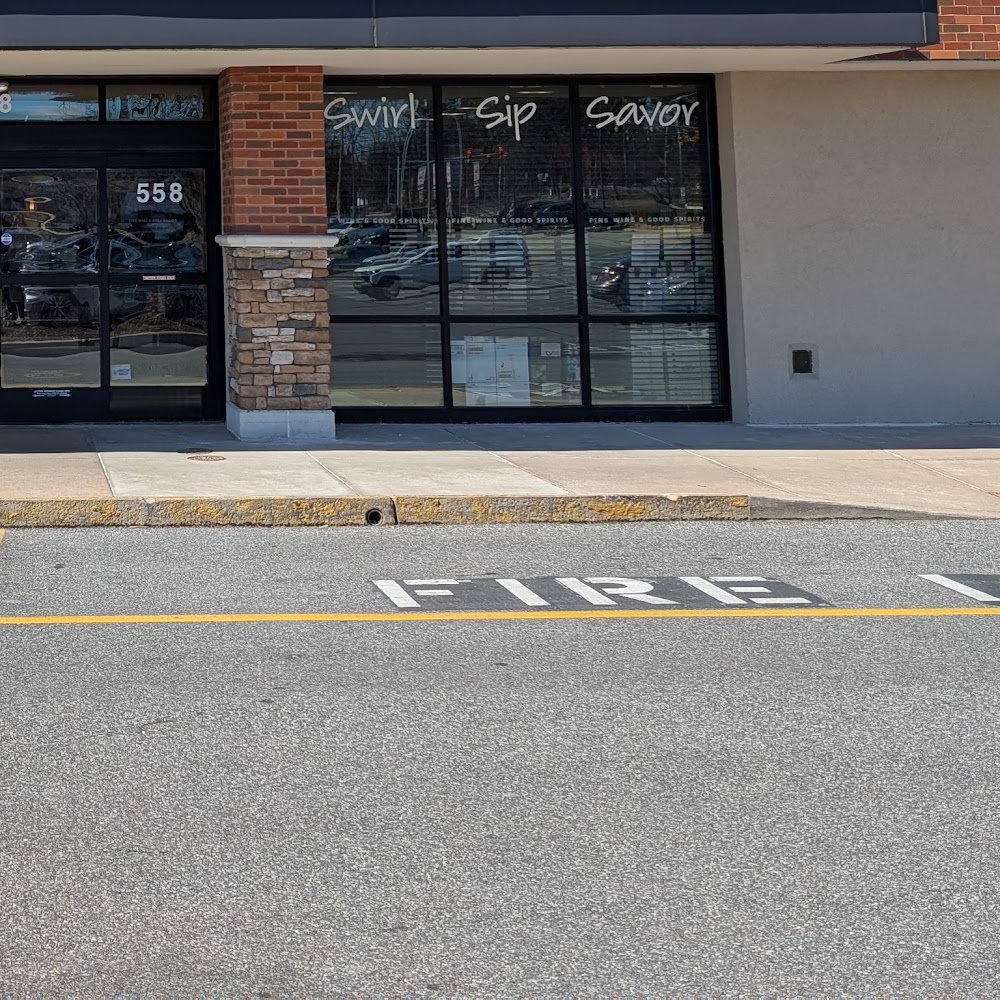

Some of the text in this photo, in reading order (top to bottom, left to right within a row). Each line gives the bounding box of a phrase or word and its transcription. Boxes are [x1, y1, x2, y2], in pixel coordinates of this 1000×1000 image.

[323, 92, 416, 131] Swirl
[475, 94, 538, 142] Sip
[585, 95, 700, 130] Savor
[136, 182, 184, 204] 558
[536, 216, 569, 224] SPIRITS
[372, 576, 812, 608] FIRE
